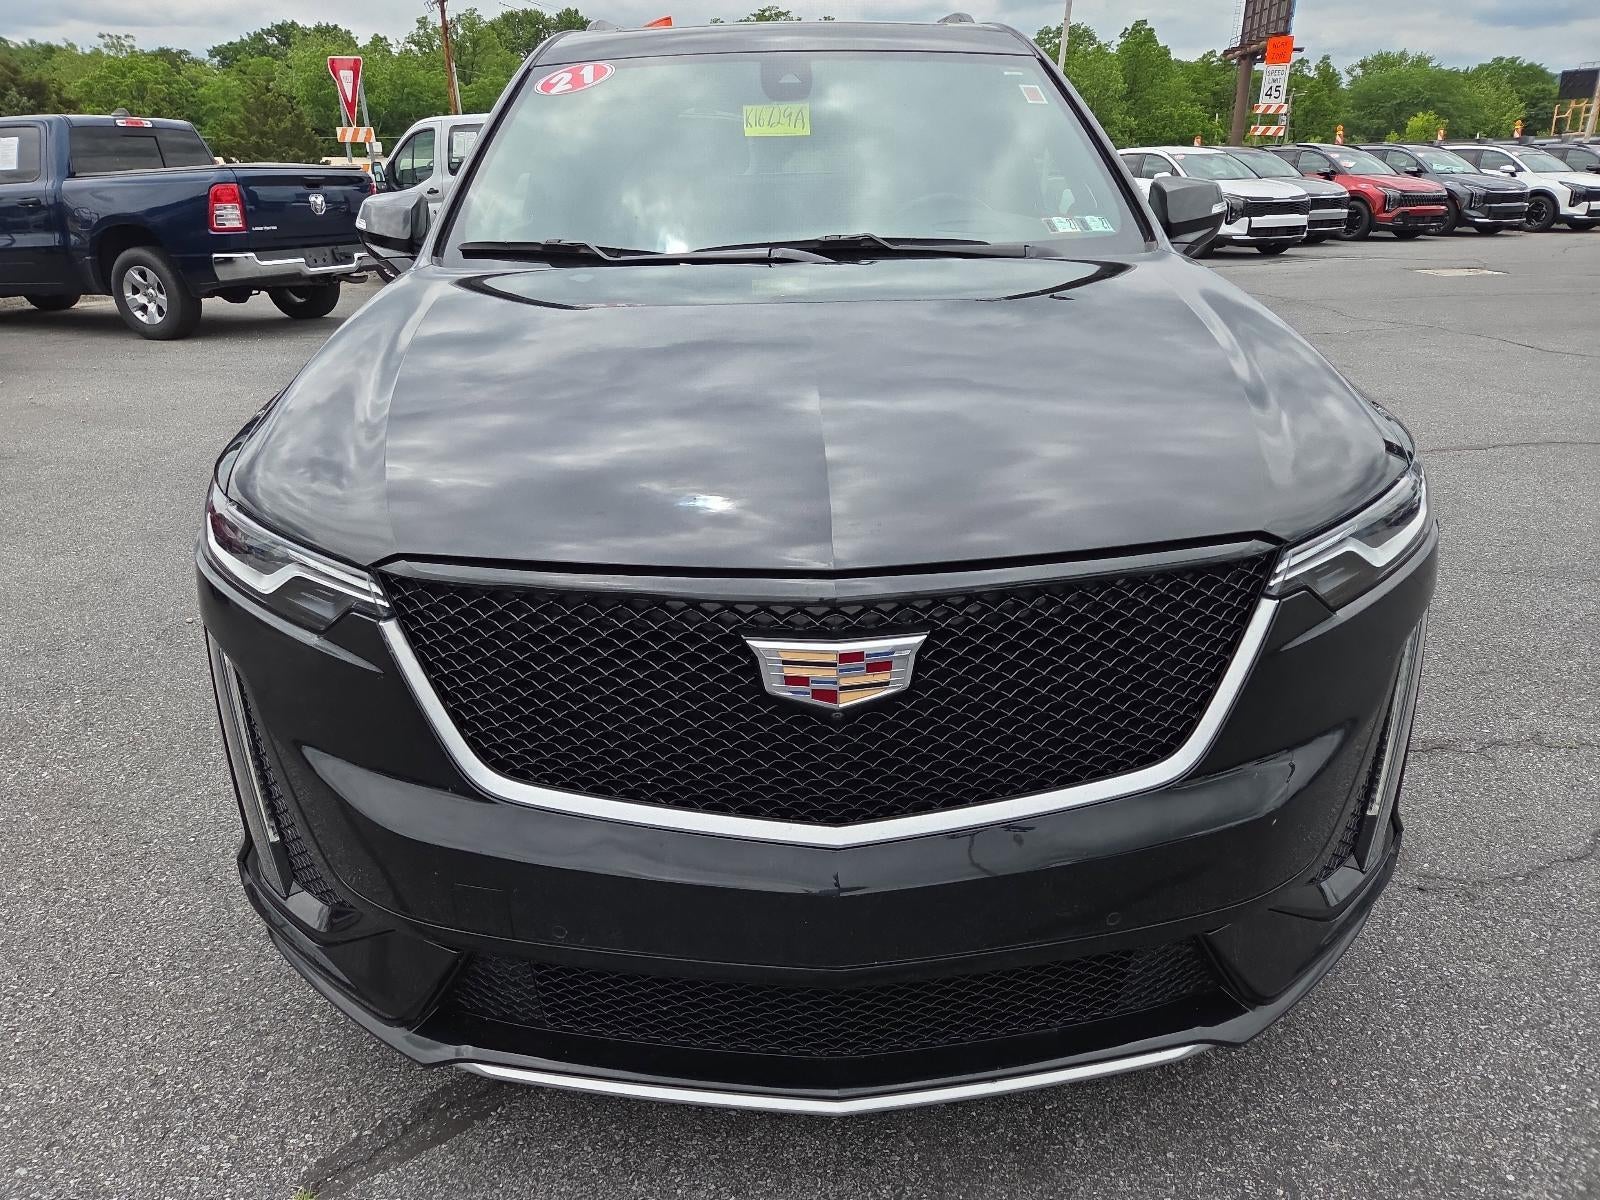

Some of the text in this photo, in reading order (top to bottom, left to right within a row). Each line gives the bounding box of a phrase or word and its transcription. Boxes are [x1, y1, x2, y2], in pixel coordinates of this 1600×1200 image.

[549, 65, 594, 94] 21
[1266, 69, 1284, 77] SPEED
[1264, 85, 1281, 99] 45
